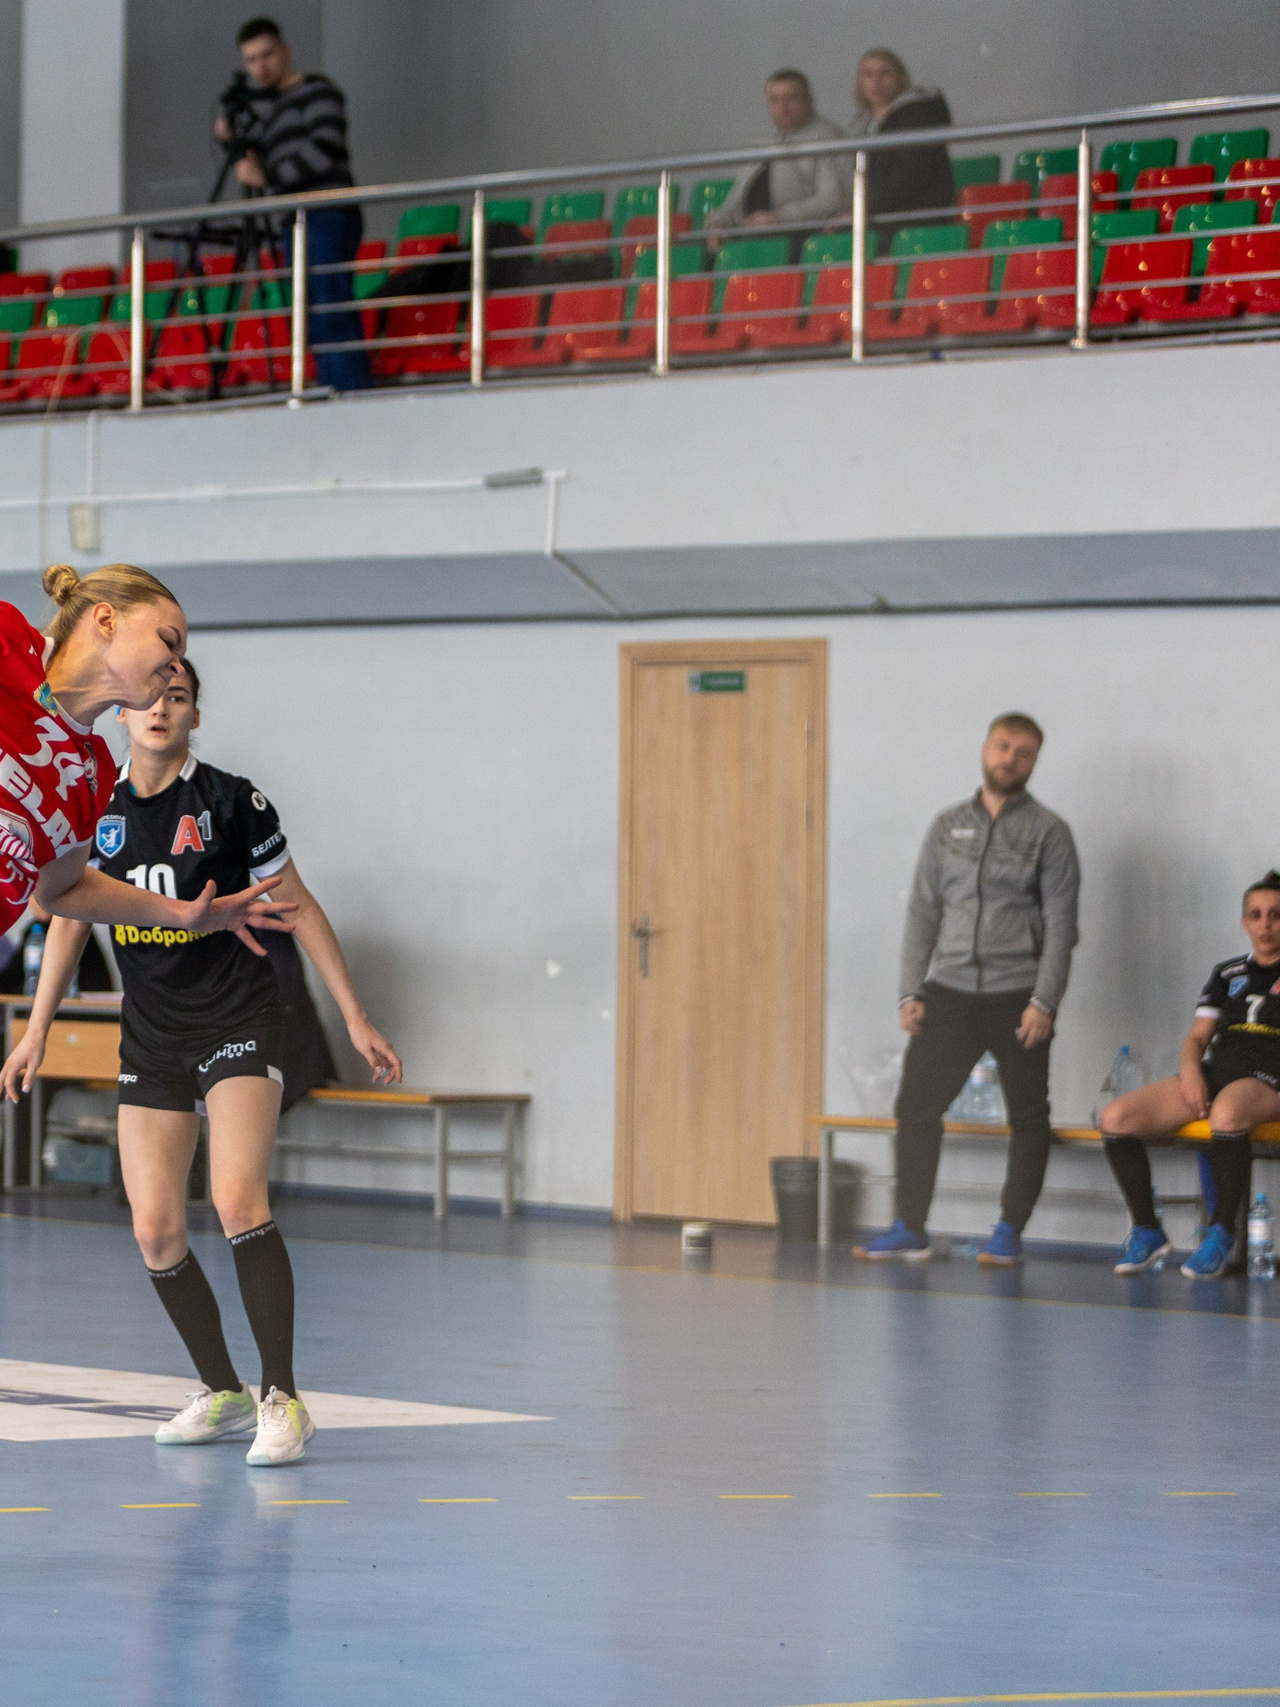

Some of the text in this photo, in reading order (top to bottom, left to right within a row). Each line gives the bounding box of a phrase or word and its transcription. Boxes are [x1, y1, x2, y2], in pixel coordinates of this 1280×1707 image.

[19, 716, 85, 801] 34
[171, 811, 212, 855] A1
[126, 863, 177, 900] 10
